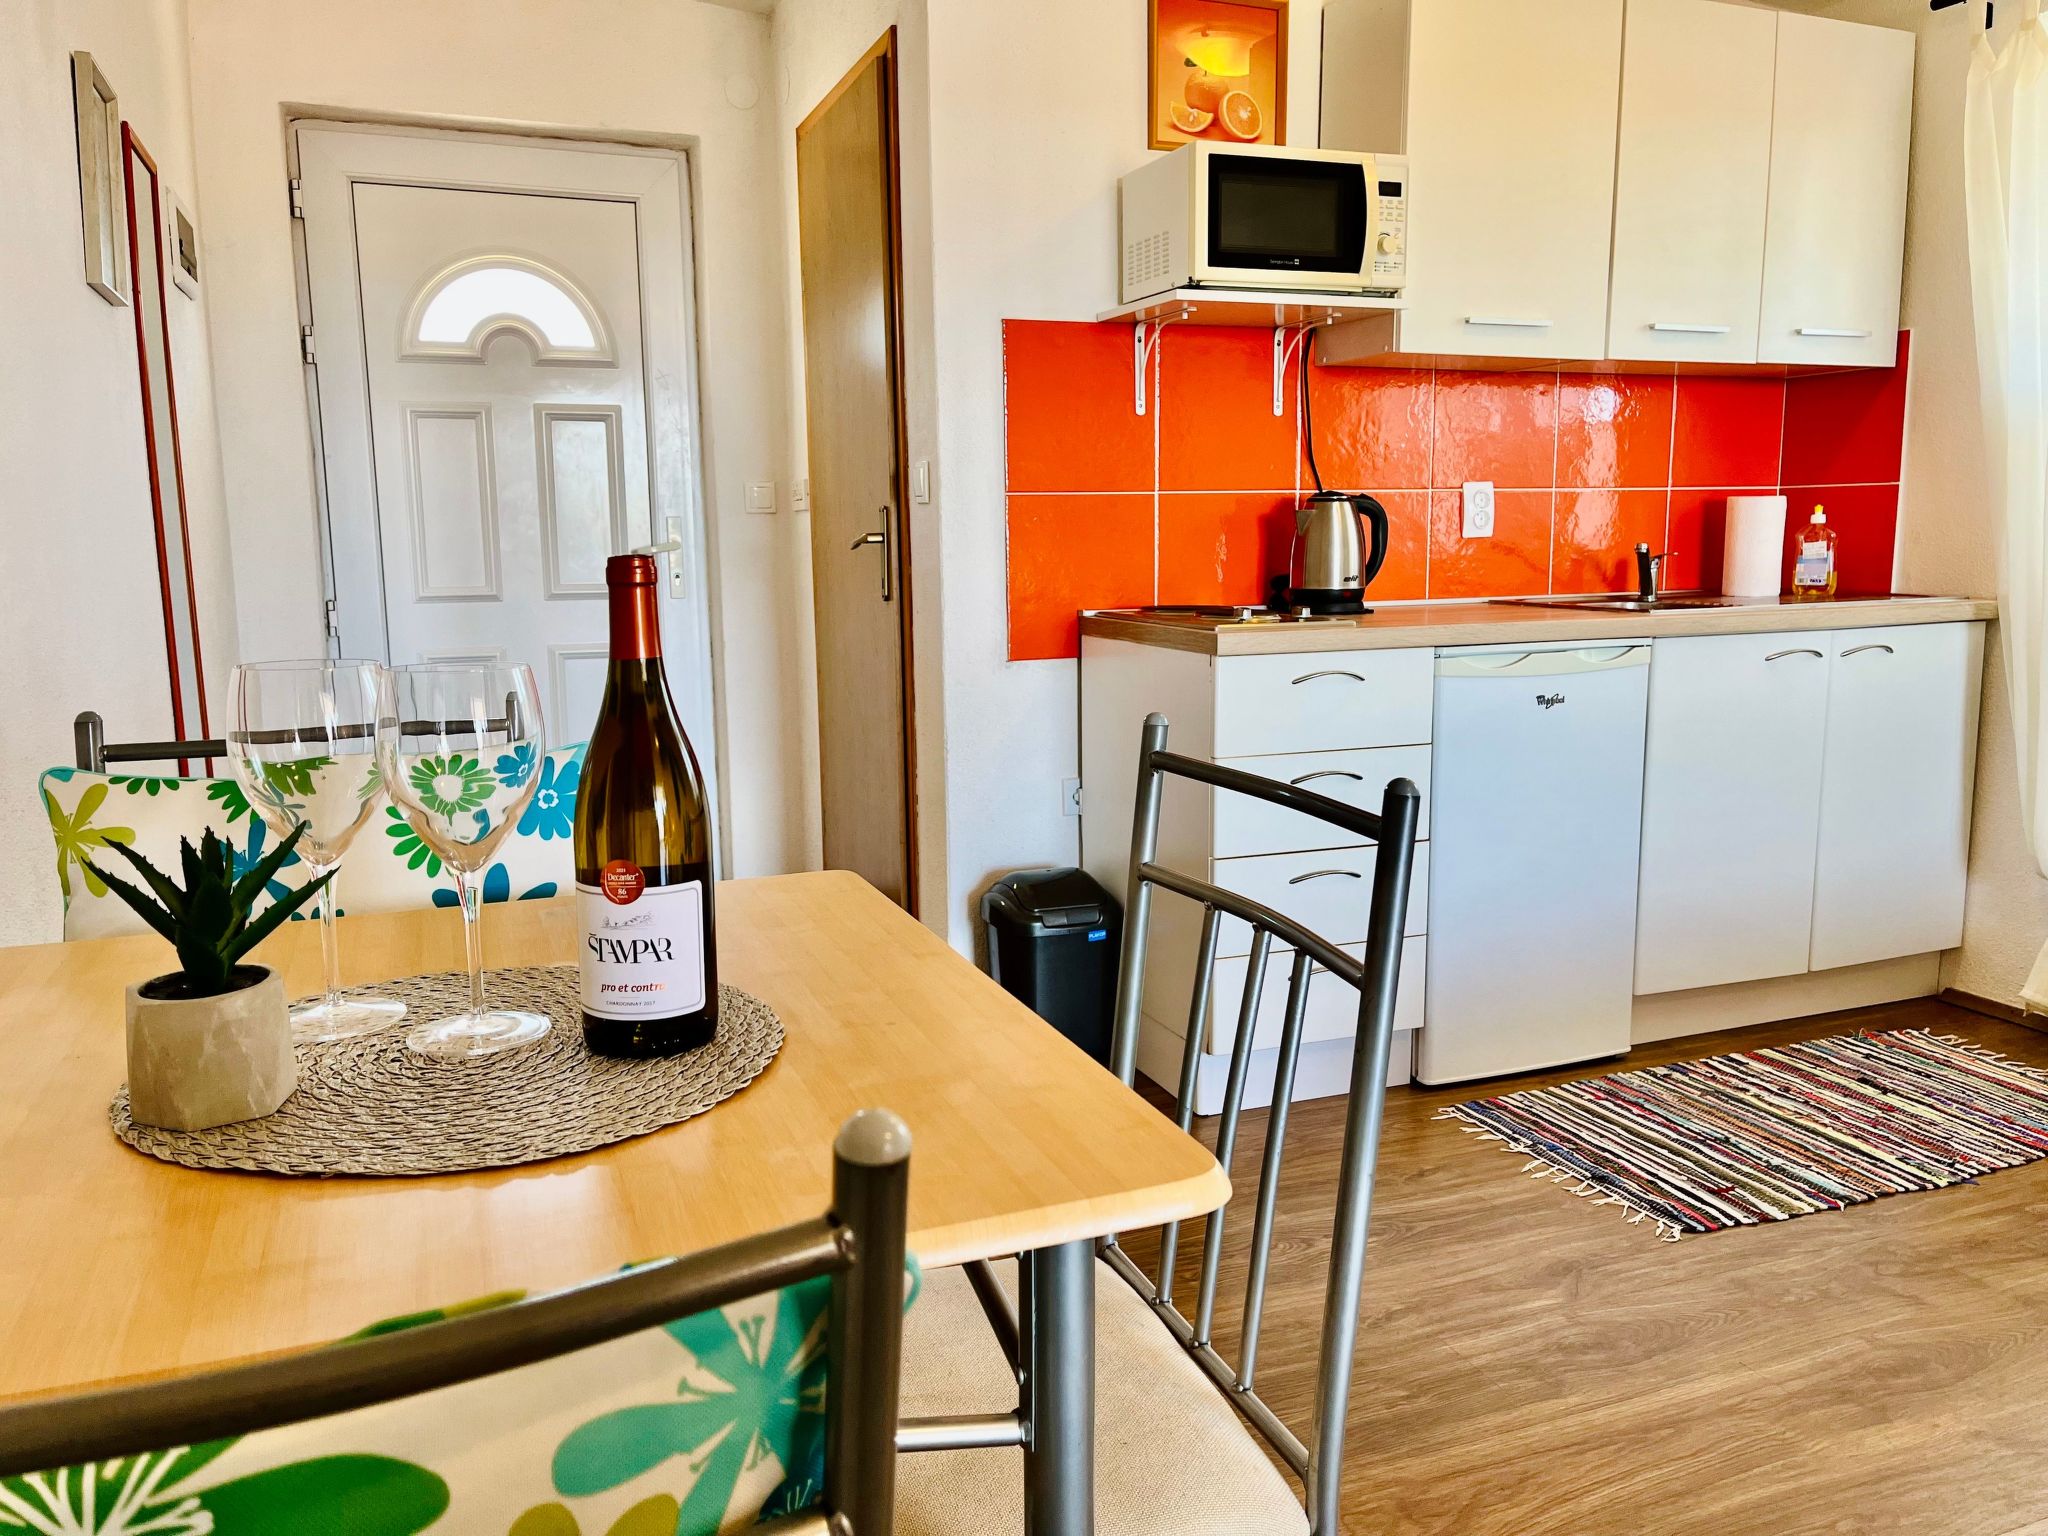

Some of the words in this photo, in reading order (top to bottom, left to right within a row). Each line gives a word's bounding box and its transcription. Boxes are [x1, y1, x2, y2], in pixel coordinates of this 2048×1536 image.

[588, 932, 675, 964] ŠTAMPAR
[600, 983, 616, 993] pro
[618, 984, 629, 992] et
